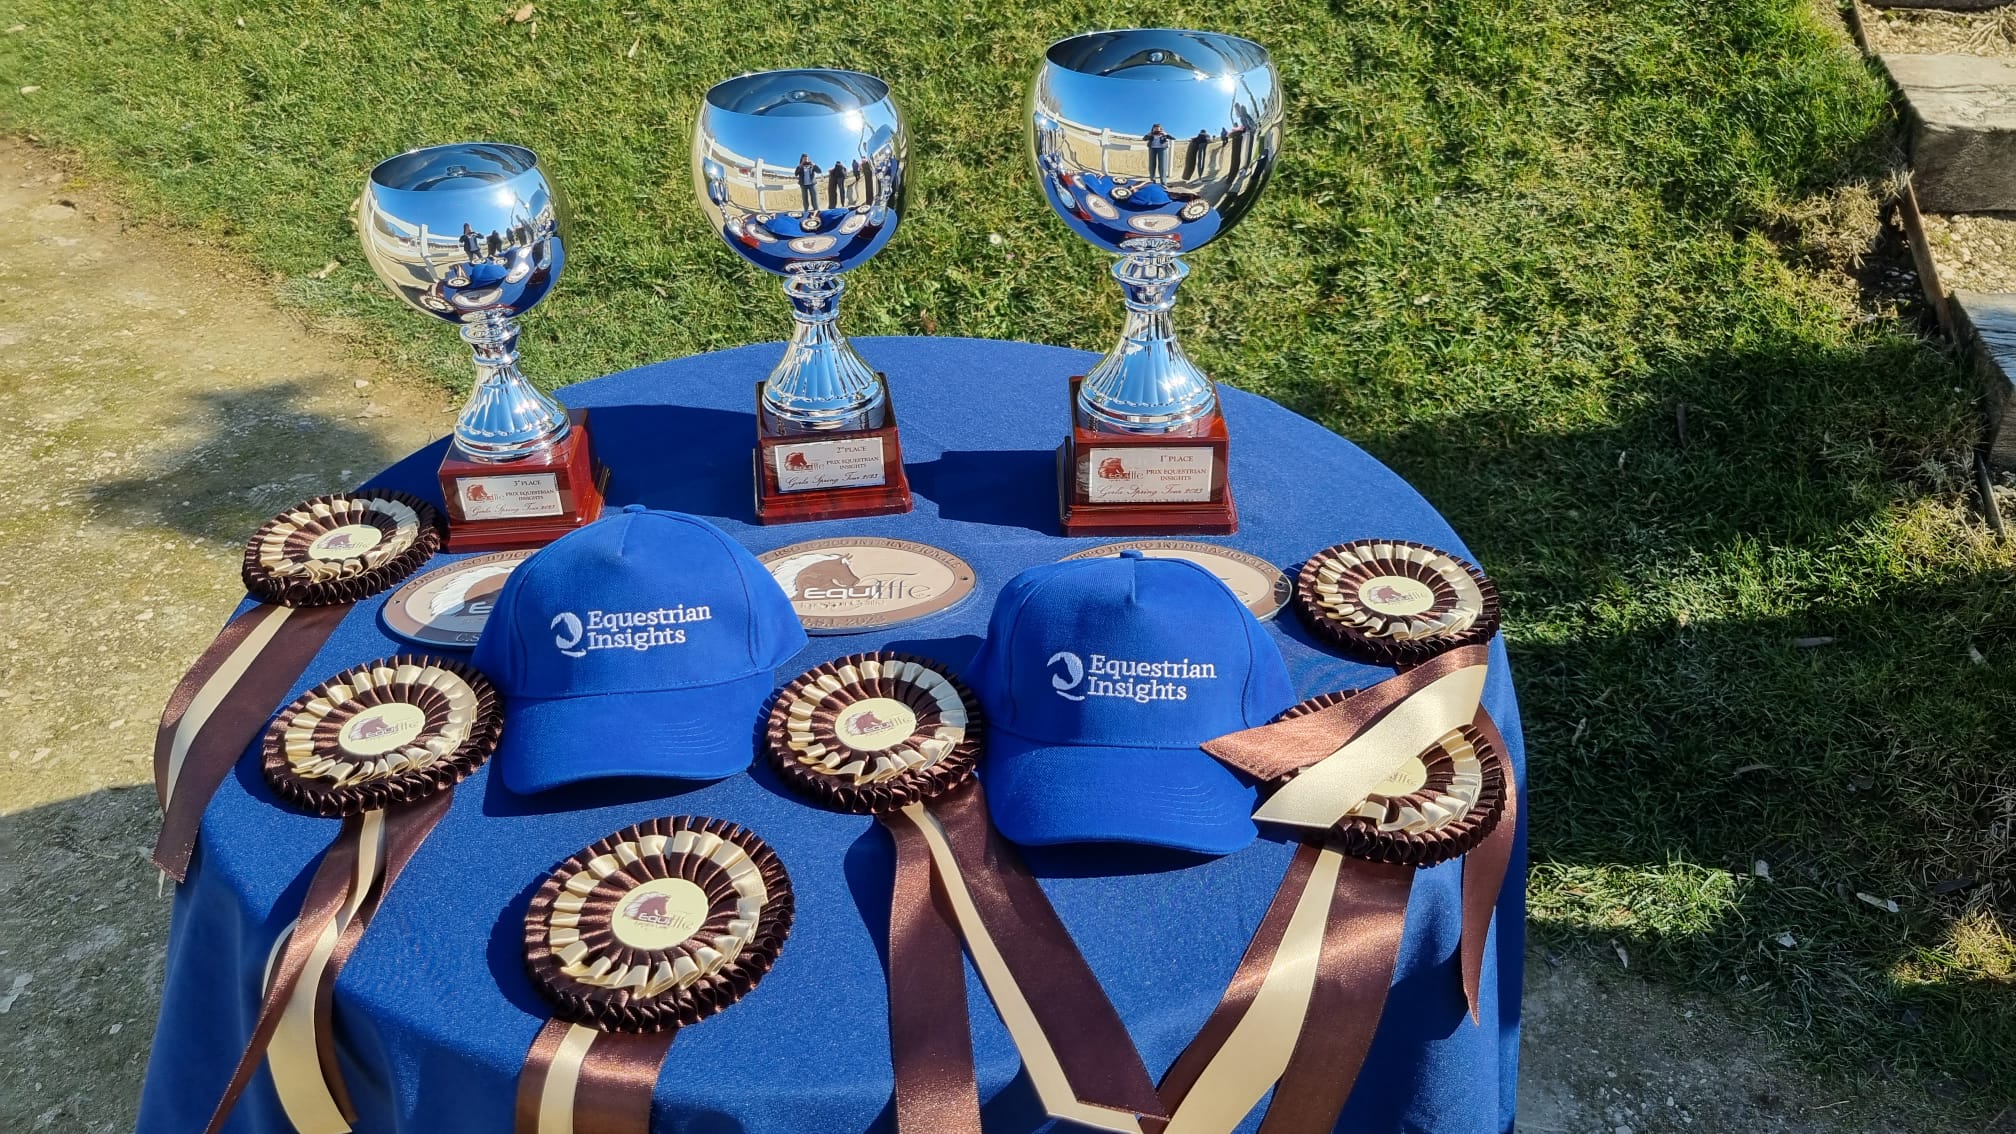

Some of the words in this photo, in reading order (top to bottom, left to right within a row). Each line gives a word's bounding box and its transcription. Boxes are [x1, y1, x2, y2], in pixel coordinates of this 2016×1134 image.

[844, 445, 867, 453] PLACE
[812, 473, 839, 486] Spring
[842, 471, 860, 481] Tour
[1127, 483, 1157, 497] Spring
[1161, 483, 1182, 495] Tour
[855, 539, 962, 568] INTERNAZIONALE
[586, 604, 712, 632] Equestrian
[587, 627, 686, 651] Insights
[1088, 654, 1217, 680] Equestrian
[1087, 676, 1188, 703] Insights
